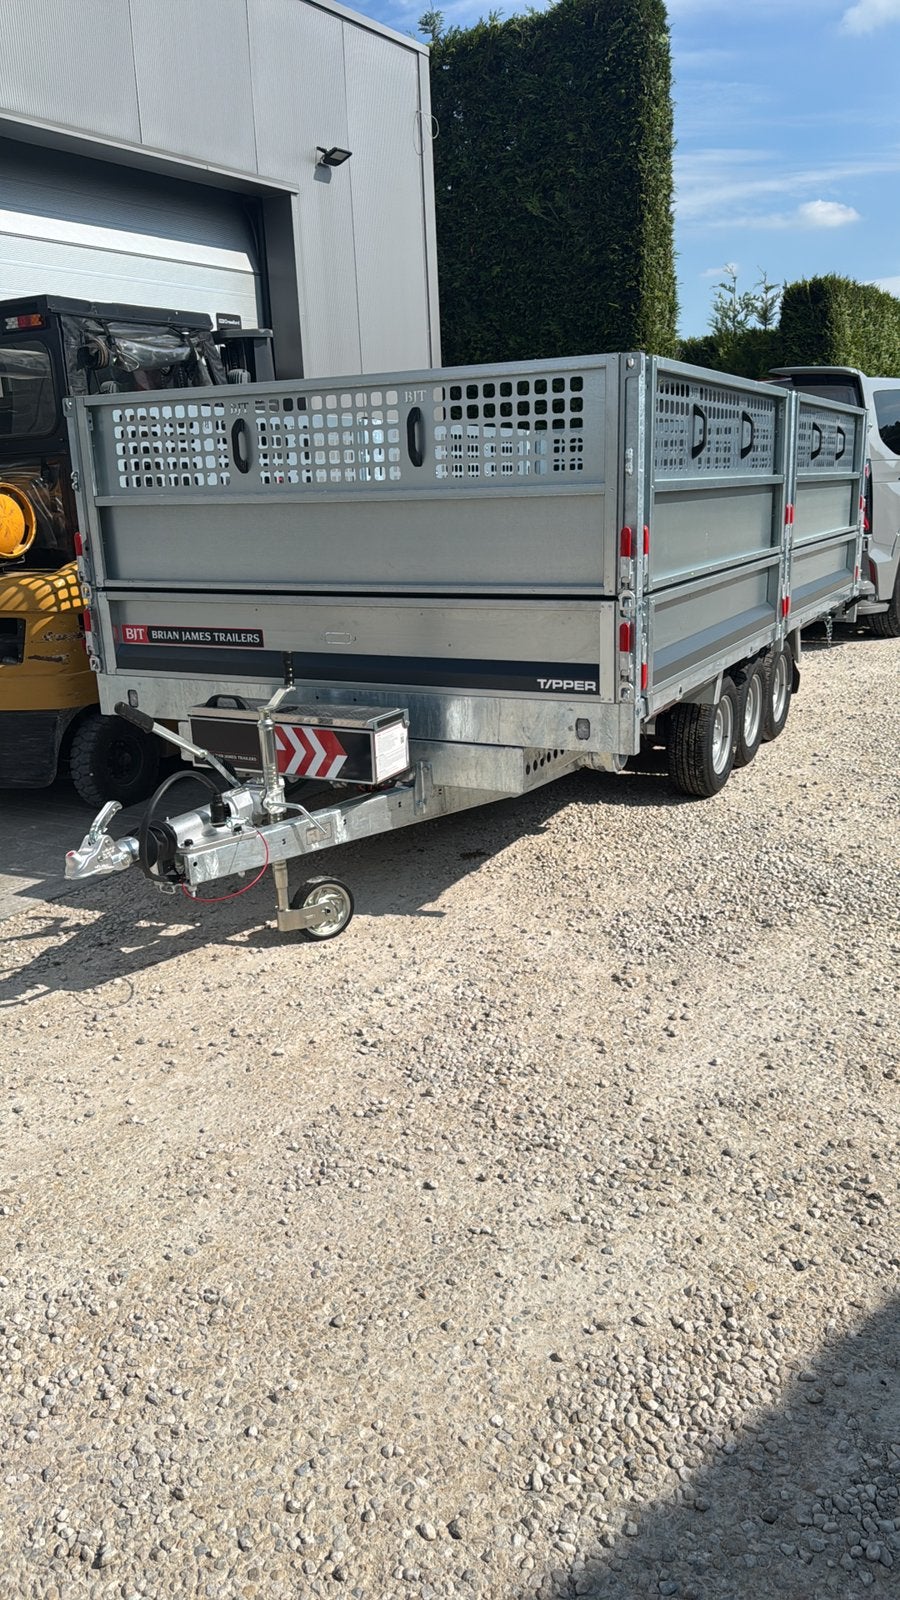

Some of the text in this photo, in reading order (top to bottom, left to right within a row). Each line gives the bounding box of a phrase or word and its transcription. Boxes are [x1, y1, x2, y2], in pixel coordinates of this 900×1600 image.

[404, 390, 427, 404] BJT
[125, 627, 145, 640] BJT
[151, 630, 260, 643] BRIAN JAMES TRAILERS
